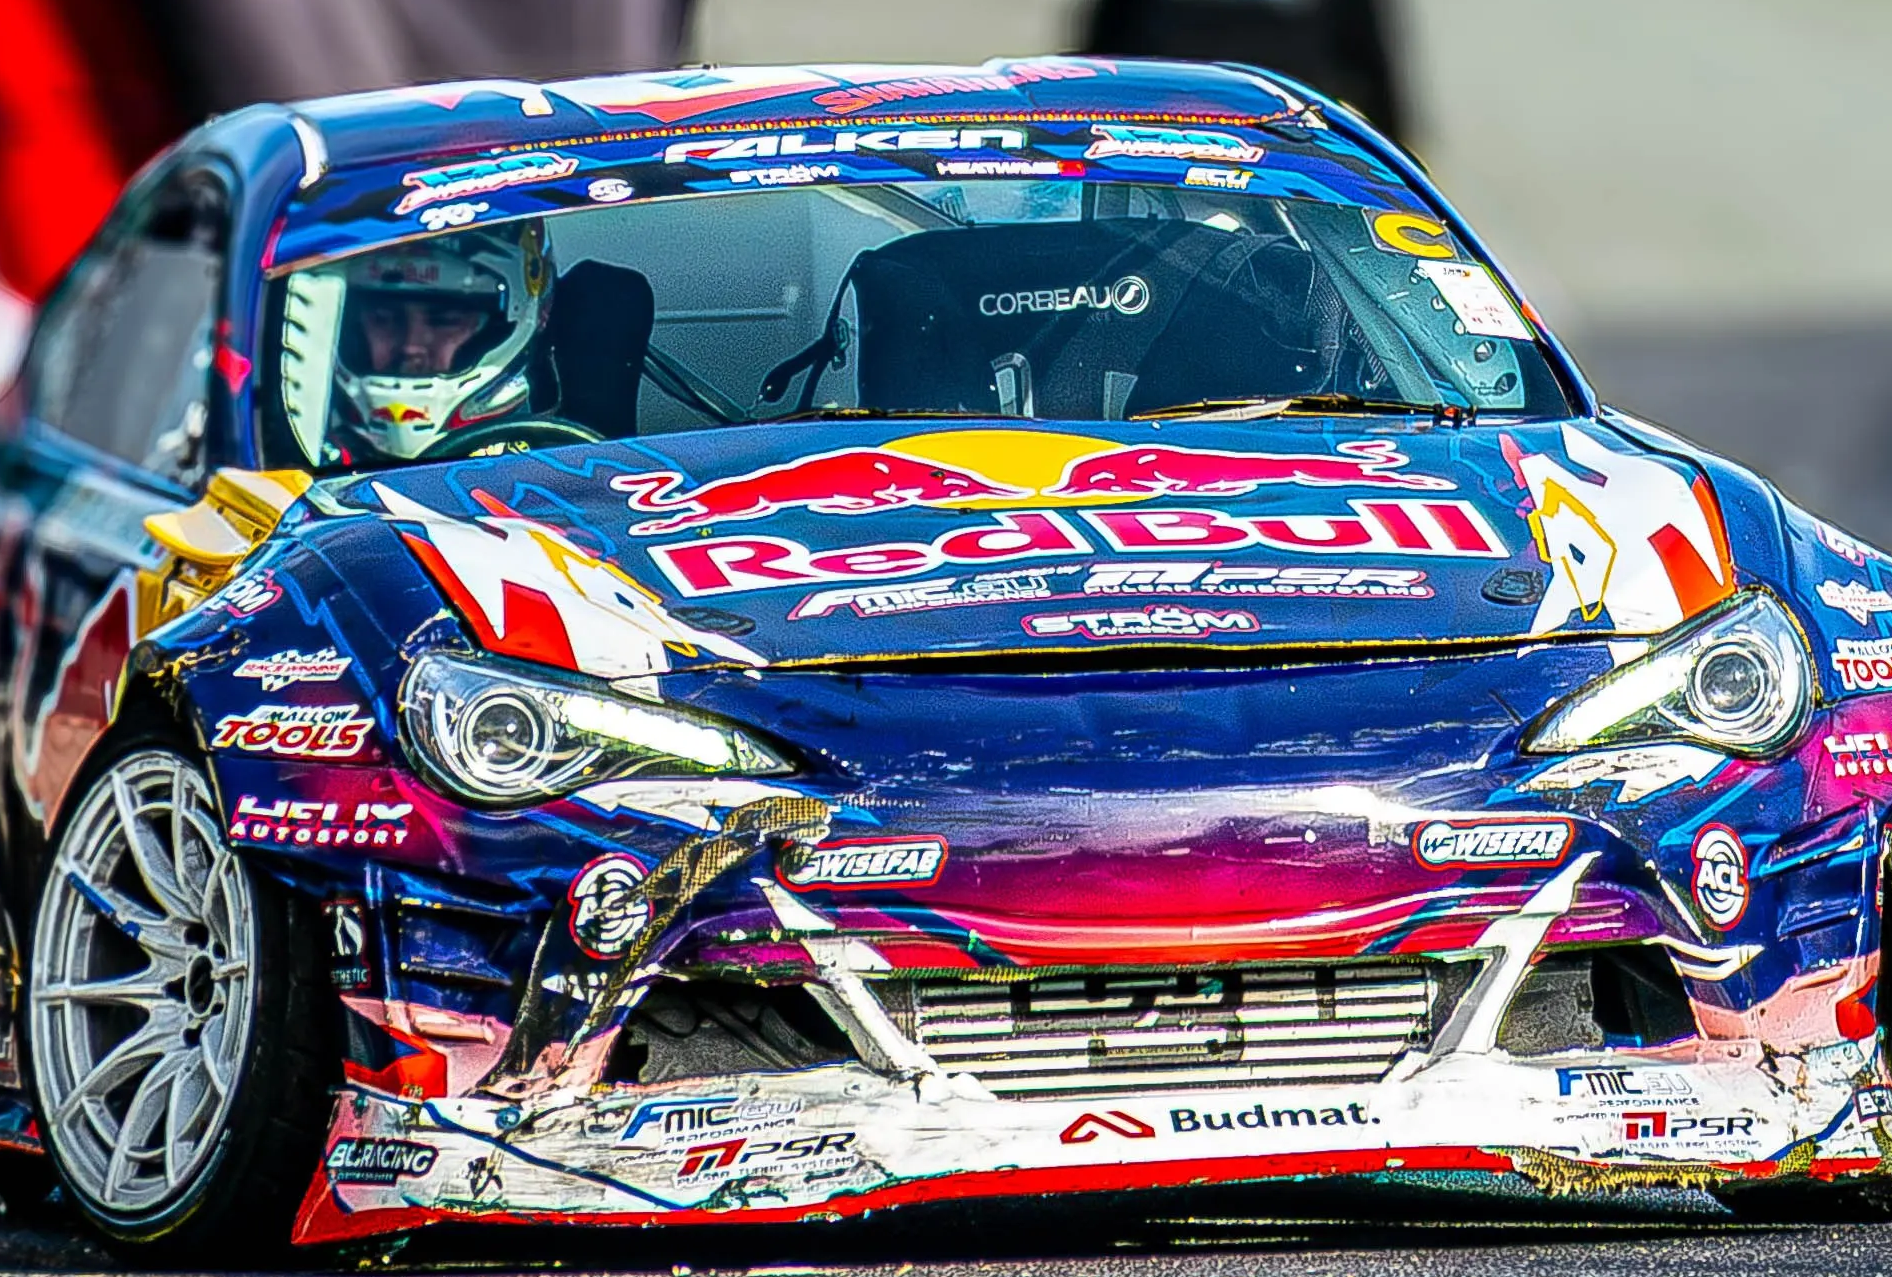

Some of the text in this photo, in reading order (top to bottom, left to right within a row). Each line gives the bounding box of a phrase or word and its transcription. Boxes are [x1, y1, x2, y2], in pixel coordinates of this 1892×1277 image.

[665, 127, 1024, 163] FALKEN
[979, 286, 1111, 316] CORBEAU
[652, 500, 1507, 596] Red Bull
[1202, 567, 1420, 586] PSR
[1032, 608, 1250, 633] STRÖM
[217, 720, 367, 751] TOOLS
[235, 796, 413, 828] HELIX
[229, 822, 408, 845] AUTOSPORT
[1454, 831, 1565, 857] WISEFAB
[820, 849, 943, 876] WISEFAB
[1697, 860, 1745, 896] ACL
[1169, 1101, 1381, 1133] Budmat.
[1670, 1117, 1754, 1137] PSR
[739, 1132, 857, 1164] PSR
